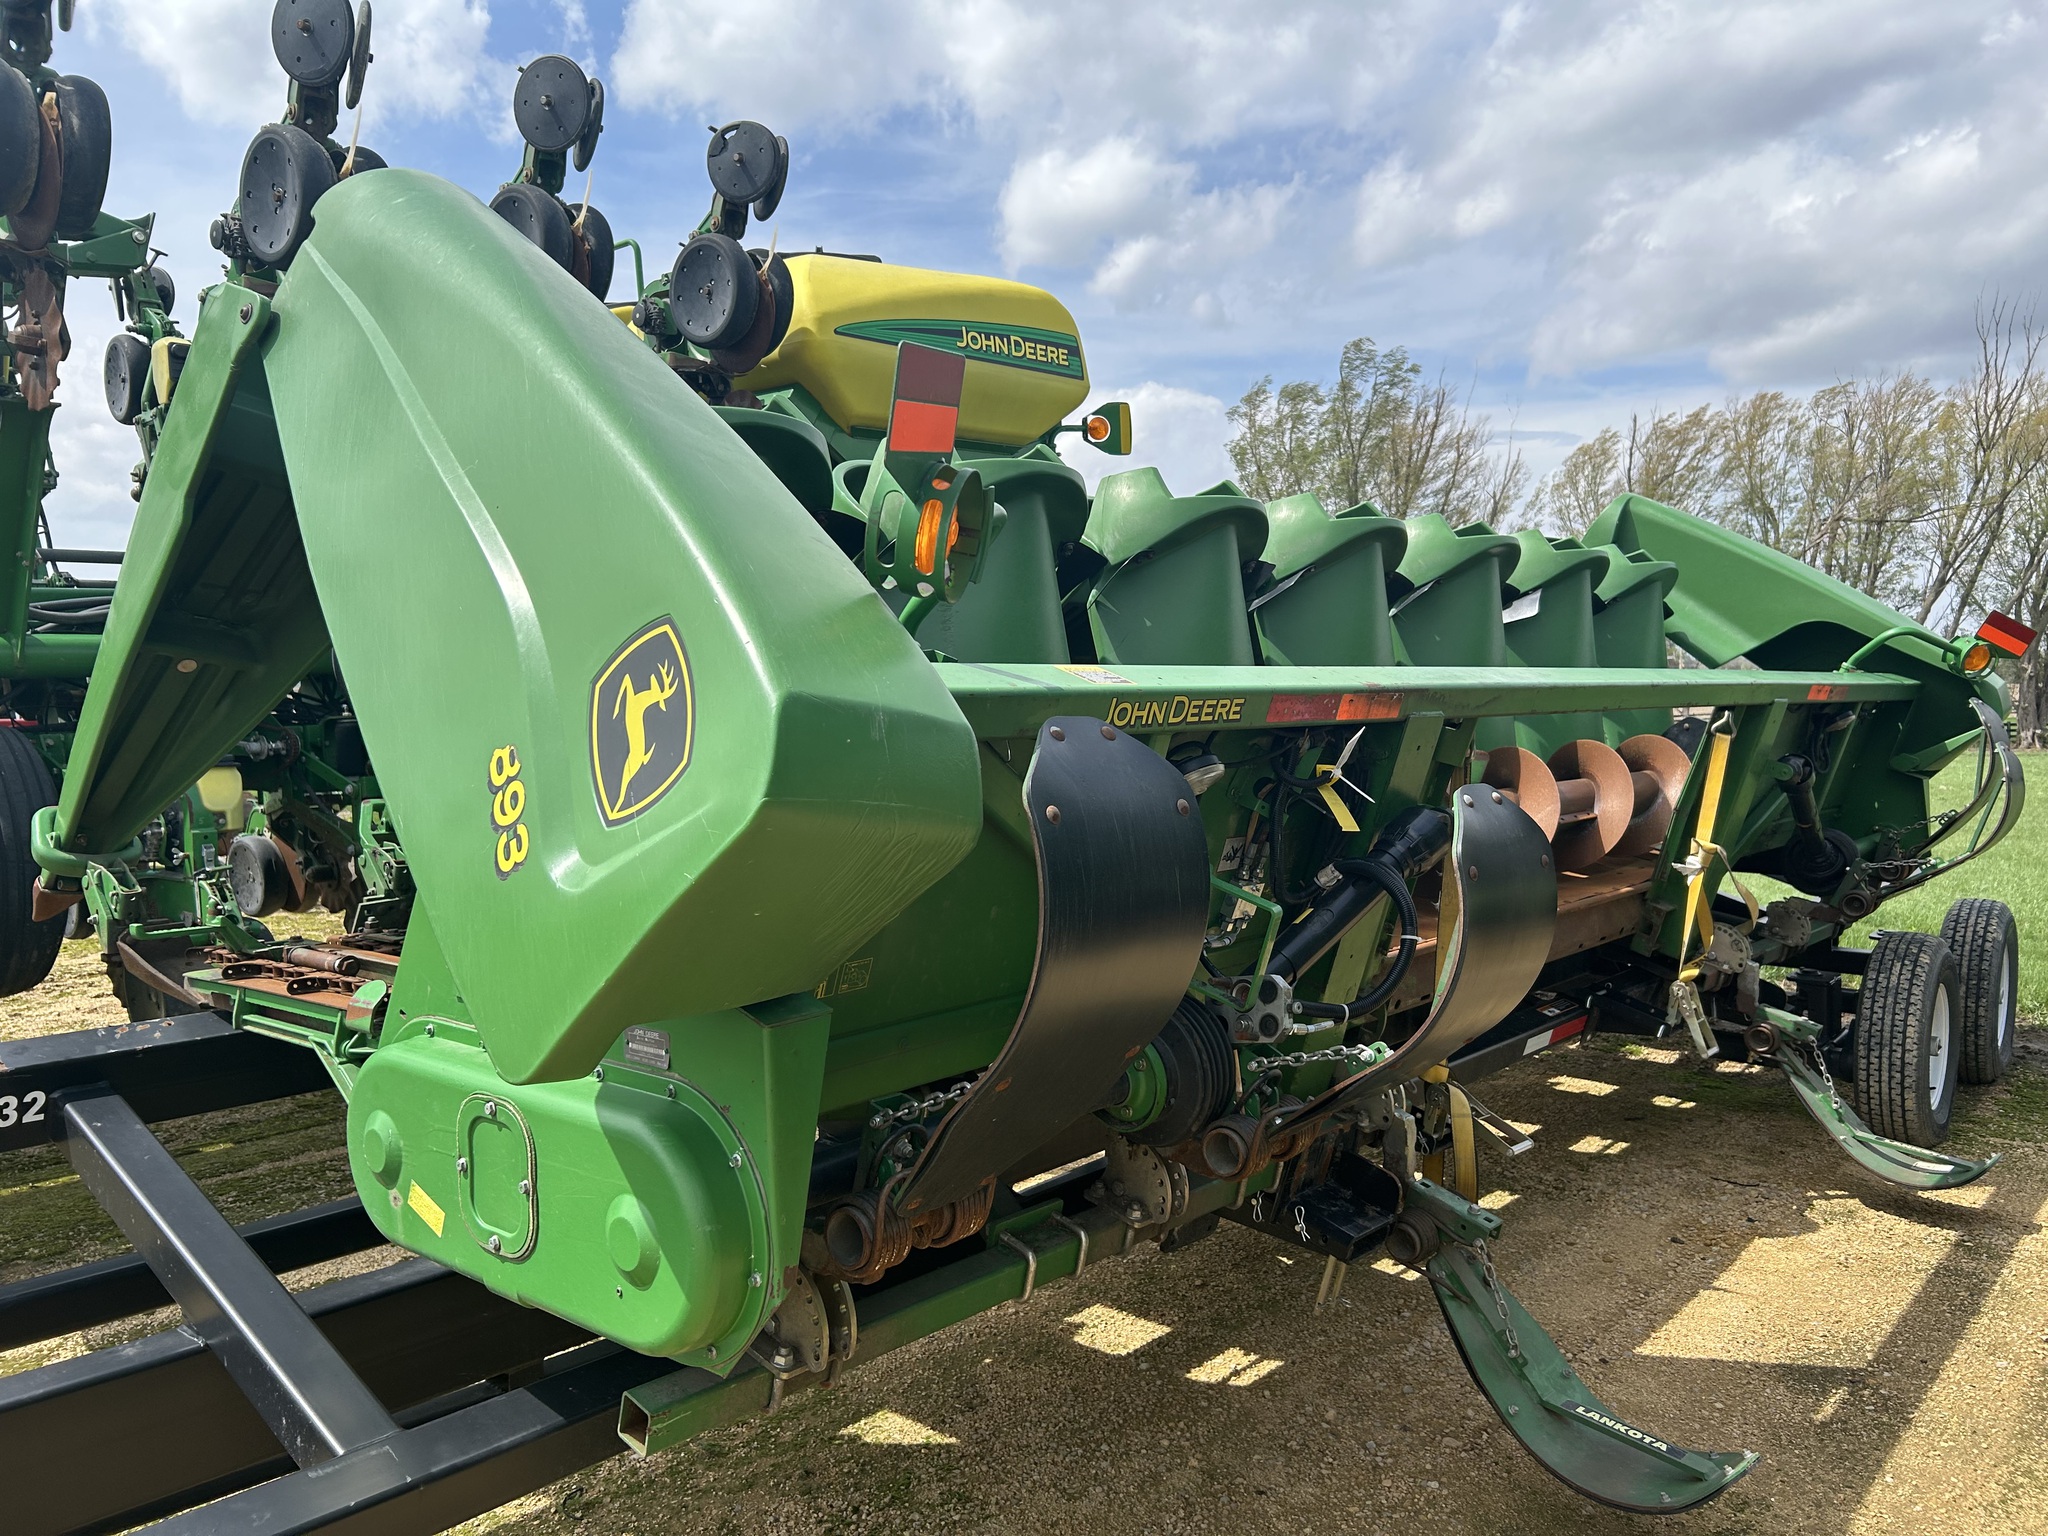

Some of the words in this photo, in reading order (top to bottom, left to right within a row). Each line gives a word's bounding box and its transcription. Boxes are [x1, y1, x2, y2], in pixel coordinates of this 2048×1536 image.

[956, 326, 1009, 356] JOHN
[1010, 335, 1070, 366] DEERE
[1105, 697, 1168, 728] JOHN
[1168, 695, 1245, 724] DEERE
[488, 744, 529, 880] 893
[0, 1090, 46, 1128] 32
[1575, 1406, 1668, 1452] LANKOTA
